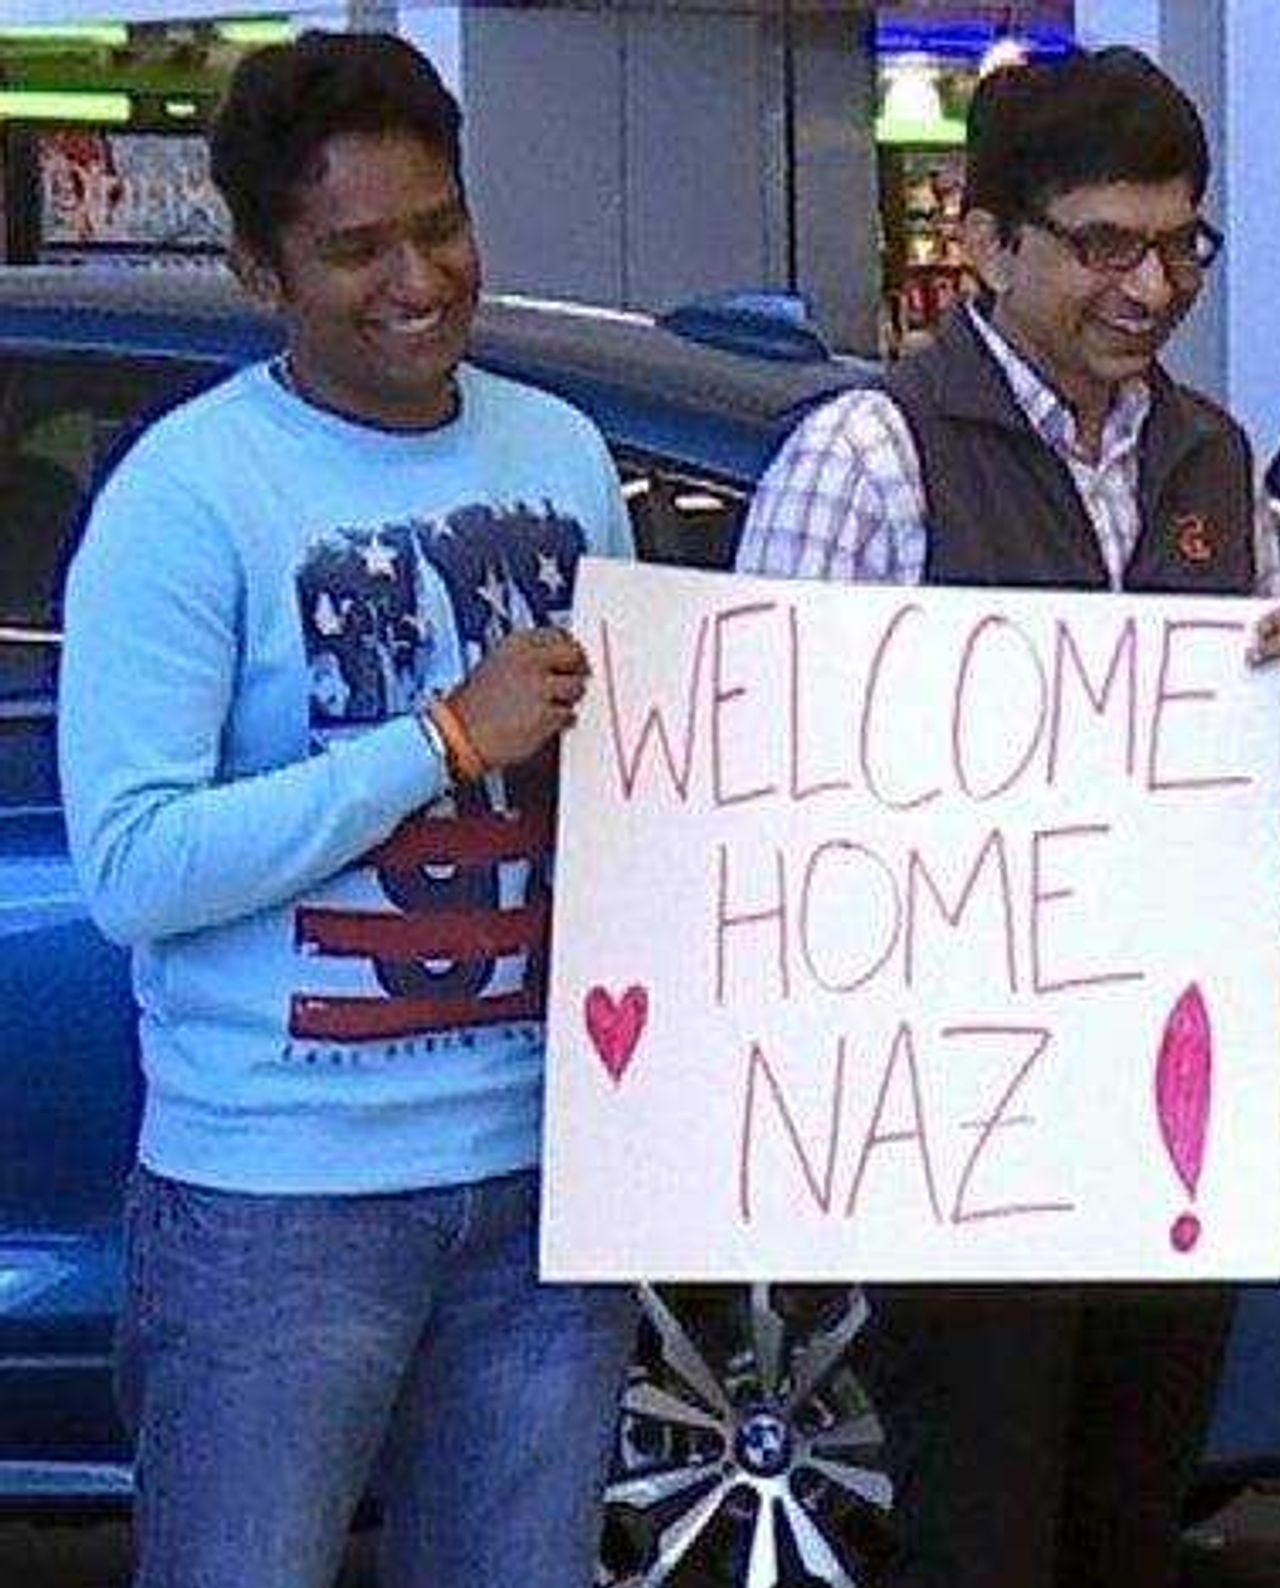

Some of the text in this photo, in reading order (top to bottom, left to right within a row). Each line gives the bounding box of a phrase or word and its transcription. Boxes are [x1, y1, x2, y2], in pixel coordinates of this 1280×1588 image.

[601, 604, 1252, 810] WELCOME
[715, 825, 1144, 1006] HOME
[739, 1021, 1074, 1225] NAZ
